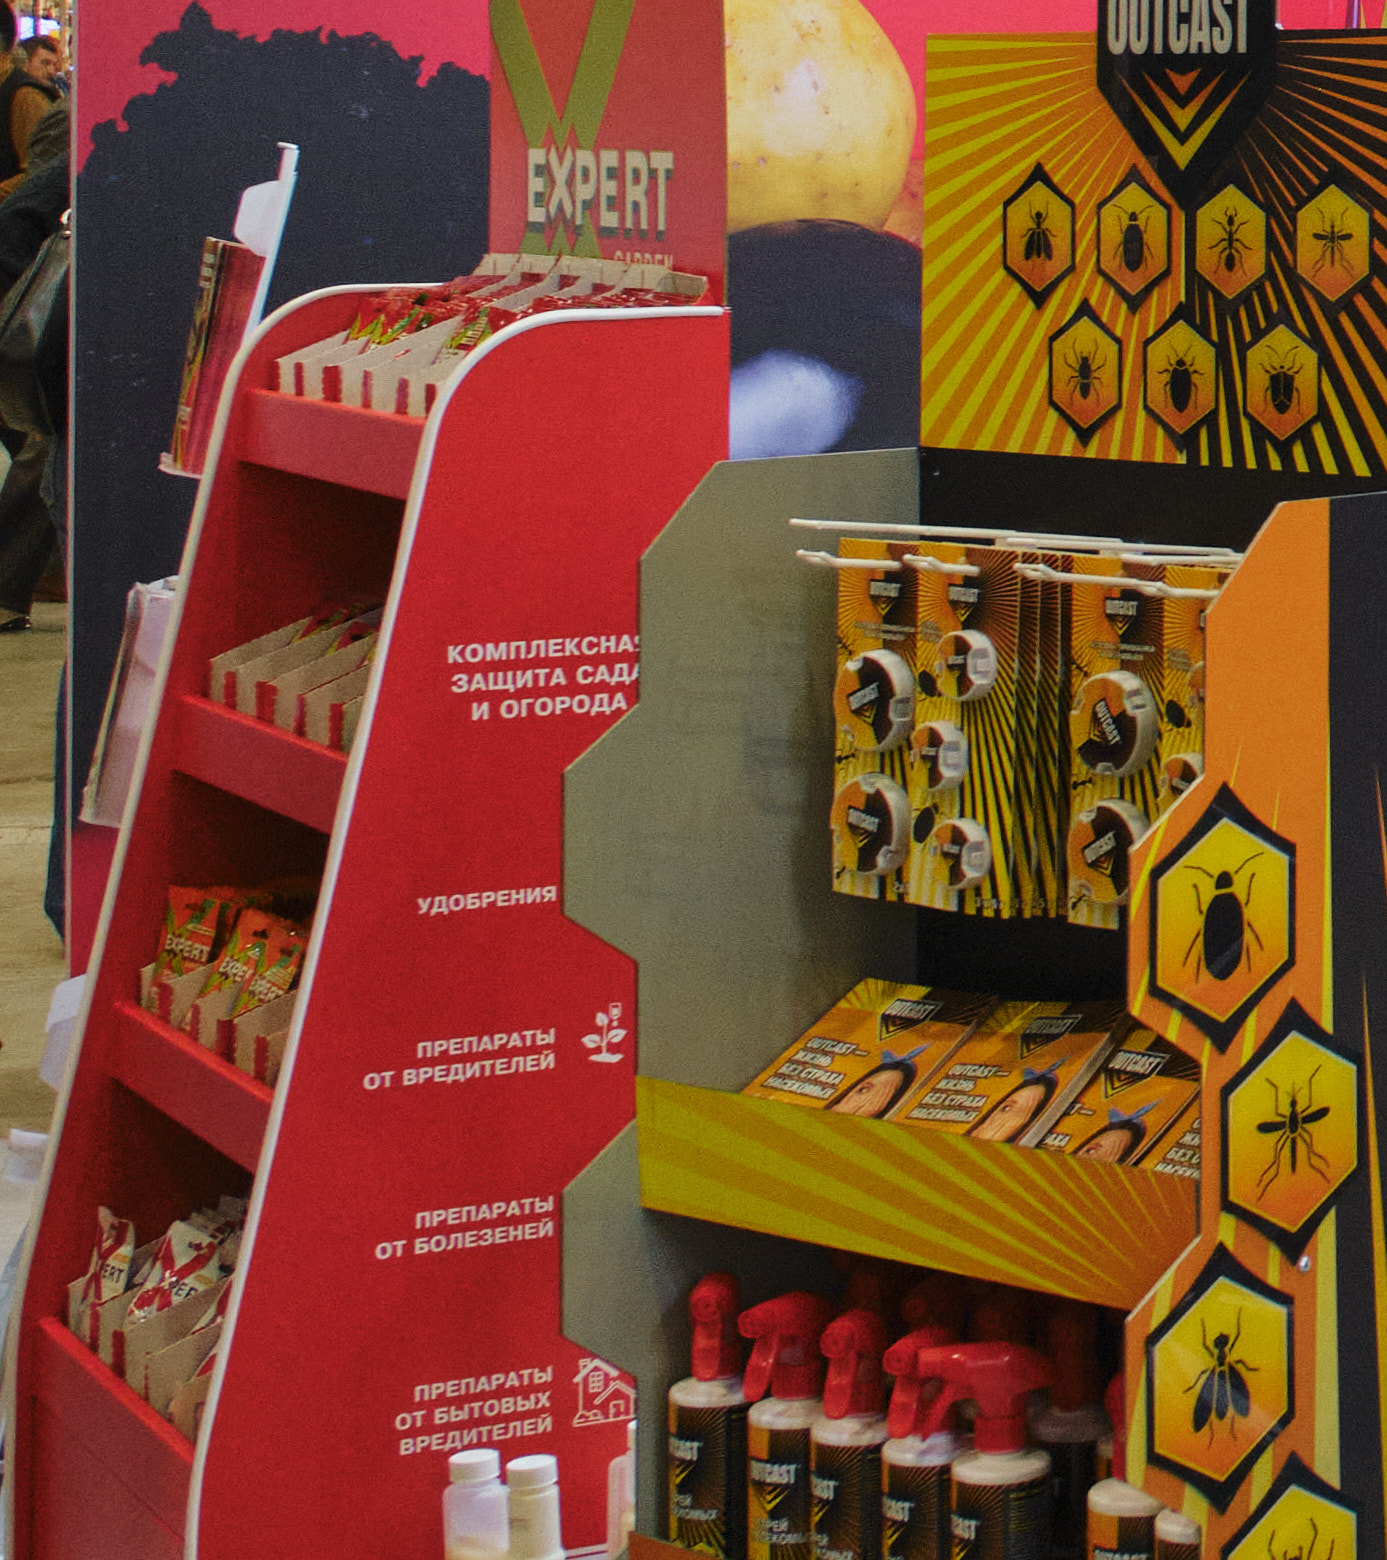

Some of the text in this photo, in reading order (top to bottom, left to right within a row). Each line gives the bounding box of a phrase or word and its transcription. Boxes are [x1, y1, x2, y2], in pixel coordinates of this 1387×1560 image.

[527, 144, 675, 240] EXPERT
[451, 668, 567, 693] ЗАЩИТА
[471, 692, 628, 721] И ОГОРОДА
[417, 885, 557, 916] УДОБРЕНИЯ
[417, 1028, 556, 1059] ПРЕПАРАТЫ
[363, 1050, 556, 1090] ОТ ВРЕДИТЕЛЕЙ
[1107, 1051, 1163, 1075] OUTCAST
[415, 1195, 554, 1229] ПРЕПАРАТЫ
[375, 1217, 554, 1260] ОТ БОЛЕЗЕНЕЙ
[414, 1366, 553, 1403] ПРЕПАРАТЫ
[394, 1391, 552, 1430] ОТ БЫТОВЫХ
[400, 1413, 553, 1456] ВРЕДИТЕЛЕЙ
